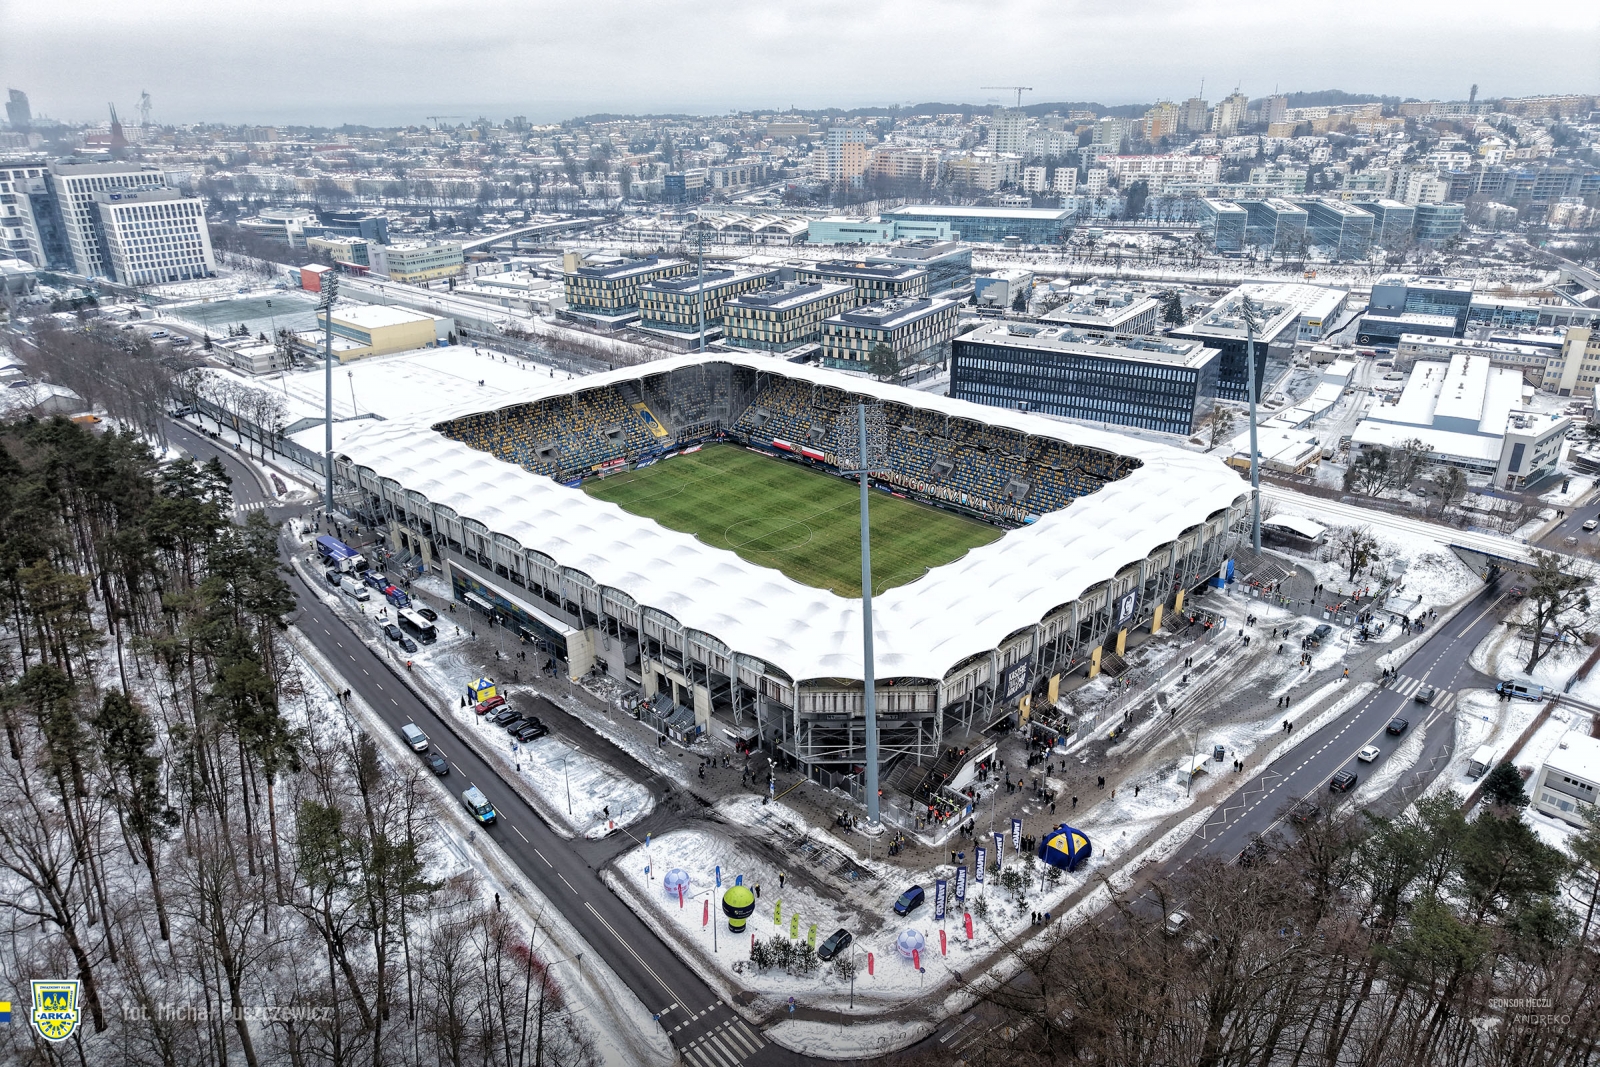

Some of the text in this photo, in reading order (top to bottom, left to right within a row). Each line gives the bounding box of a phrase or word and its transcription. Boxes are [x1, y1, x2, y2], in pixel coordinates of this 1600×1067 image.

[869, 470, 926, 492] OLSKIEGO
[928, 484, 962, 505] OKNA
[966, 493, 983, 511] NA
